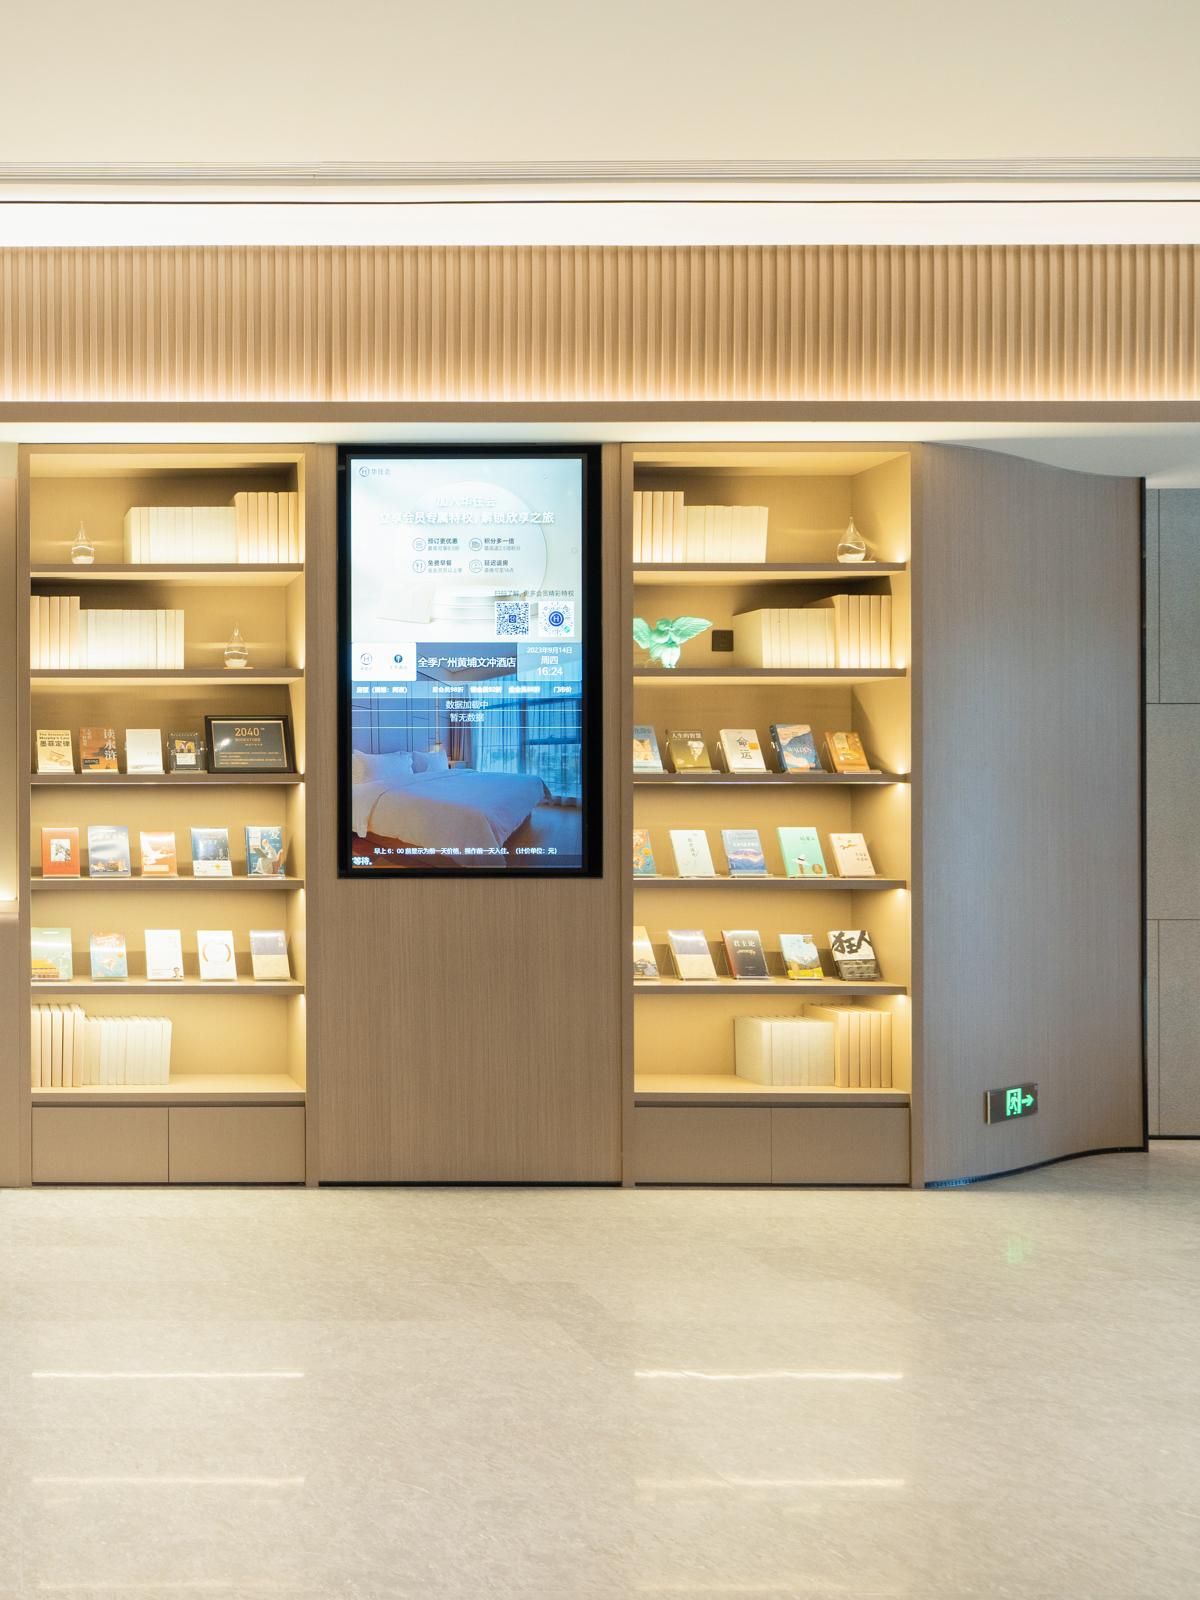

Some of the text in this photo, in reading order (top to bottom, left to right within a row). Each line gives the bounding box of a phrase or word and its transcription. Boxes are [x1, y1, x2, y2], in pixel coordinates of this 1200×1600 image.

[418, 656, 517, 668] 全季广州黄埔文冲酒店
[537, 667, 563, 676] 16:24
[445, 700, 488, 710] 数据加载中
[234, 727, 260, 737] 2040
[832, 929, 873, 954] 狂人
